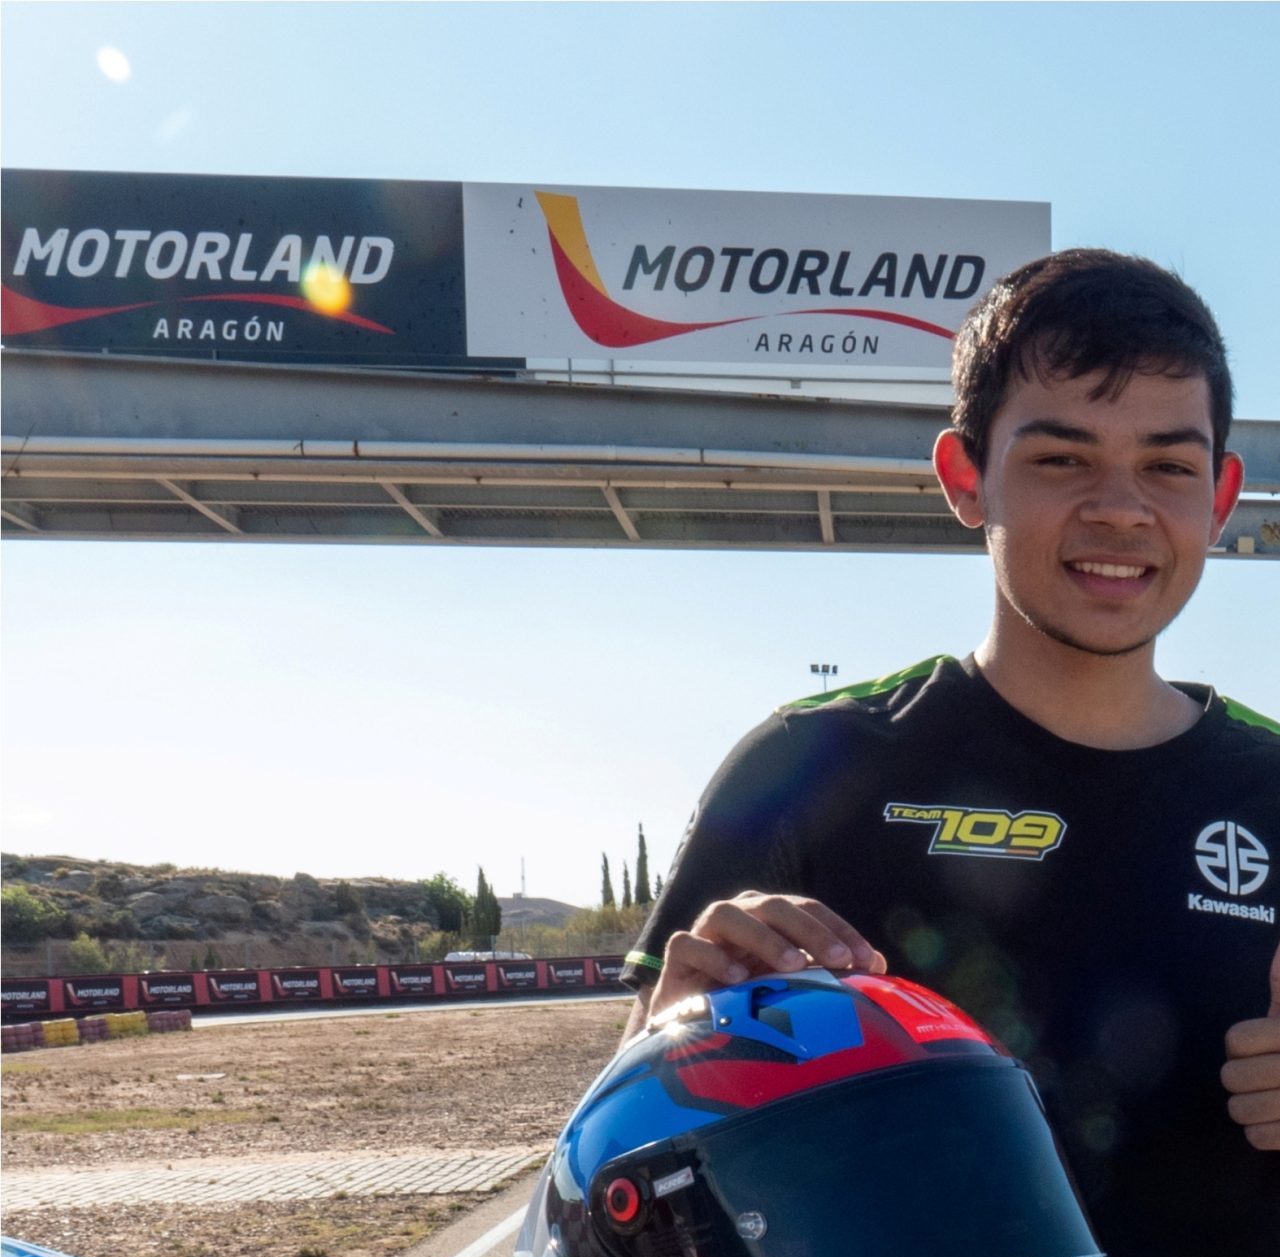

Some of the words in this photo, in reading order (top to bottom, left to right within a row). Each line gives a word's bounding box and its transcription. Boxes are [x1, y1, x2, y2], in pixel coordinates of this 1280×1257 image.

[13, 227, 396, 286] MOTORLAND
[621, 244, 986, 301] MOTORLAND
[152, 317, 285, 343] ARAGÓN
[754, 330, 880, 356] ARAGÓN
[891, 807, 942, 820] TEAM
[939, 811, 1060, 847] 109
[1187, 893, 1275, 924] Kawasaki
